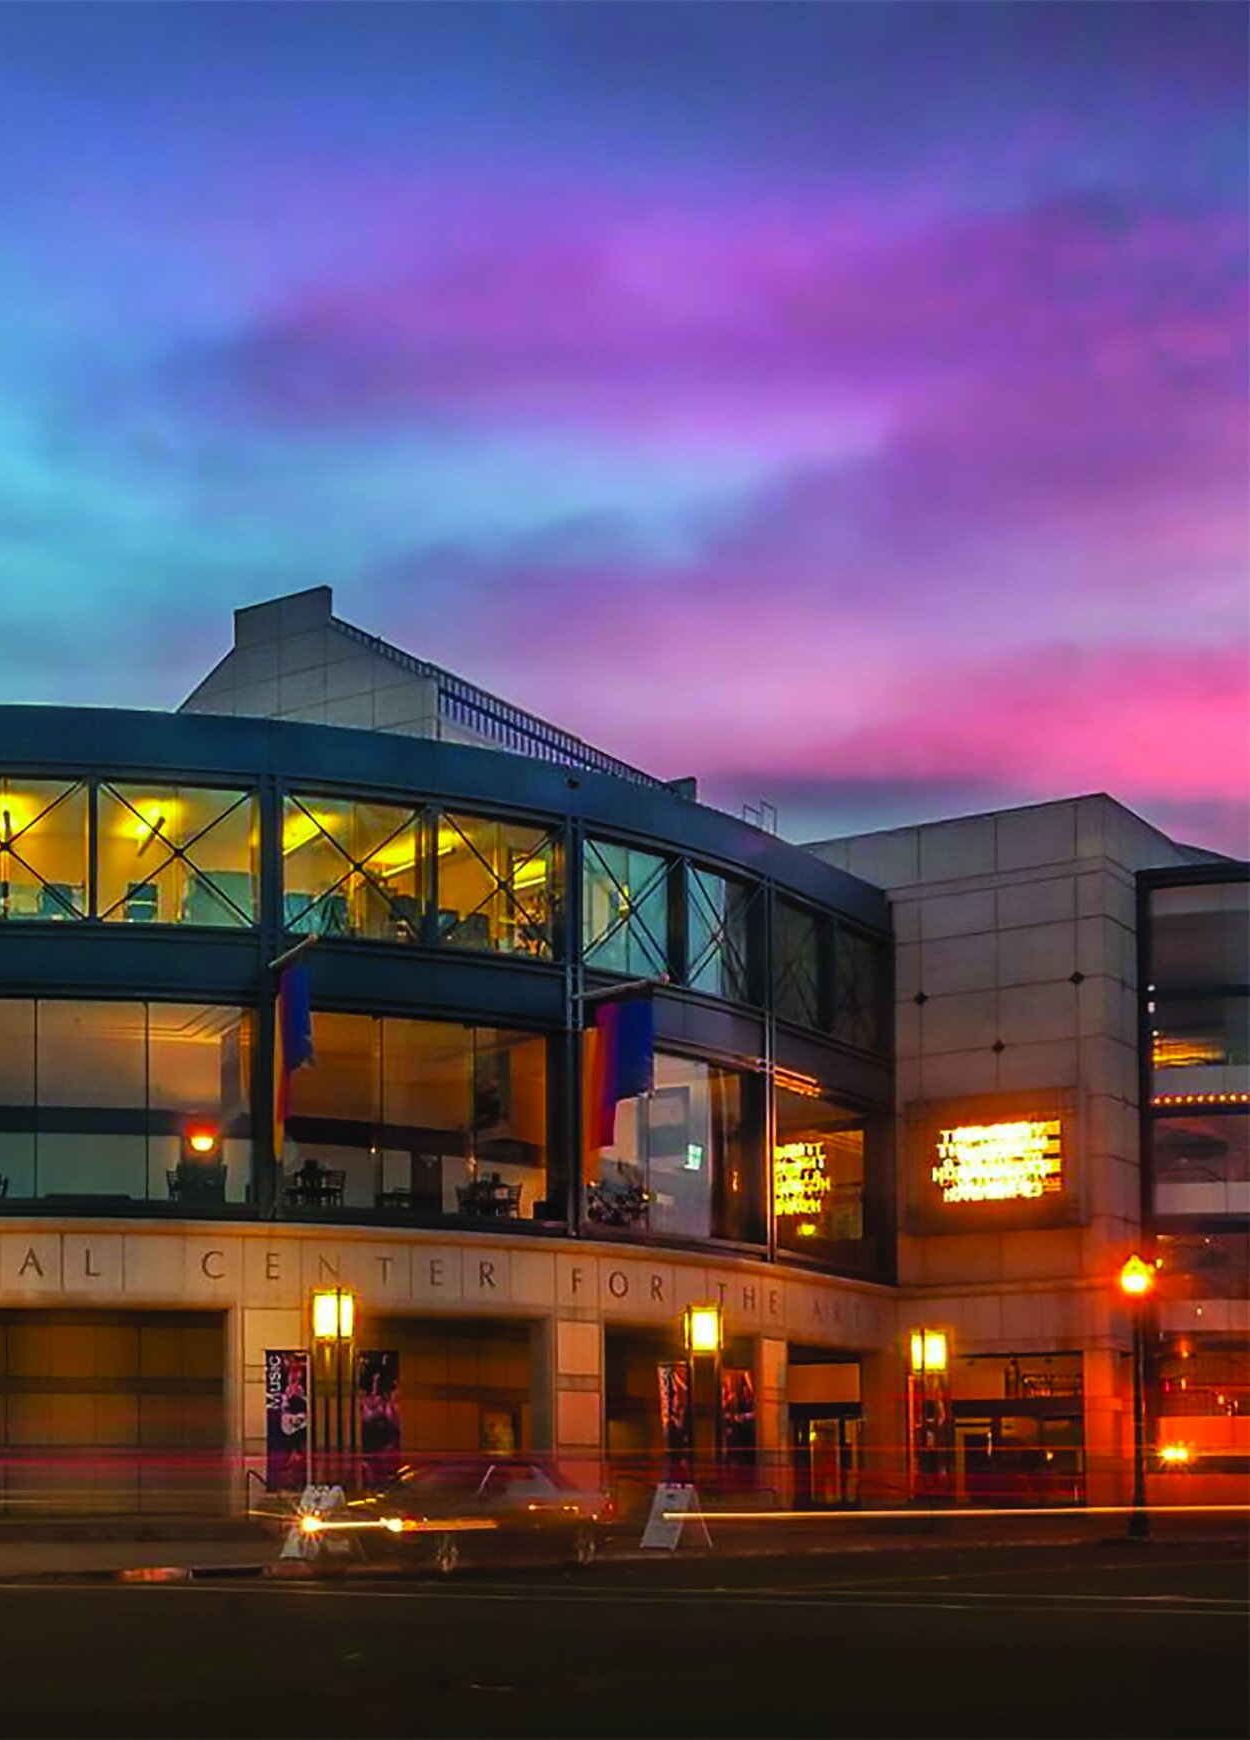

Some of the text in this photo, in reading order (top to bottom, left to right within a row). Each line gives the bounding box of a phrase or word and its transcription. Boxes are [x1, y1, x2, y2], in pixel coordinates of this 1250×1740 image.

[201, 1251, 496, 1288] CENTER
[571, 1268, 663, 1301] FOR
[717, 1283, 777, 1314] THE
[266, 1355, 282, 1409] Music
